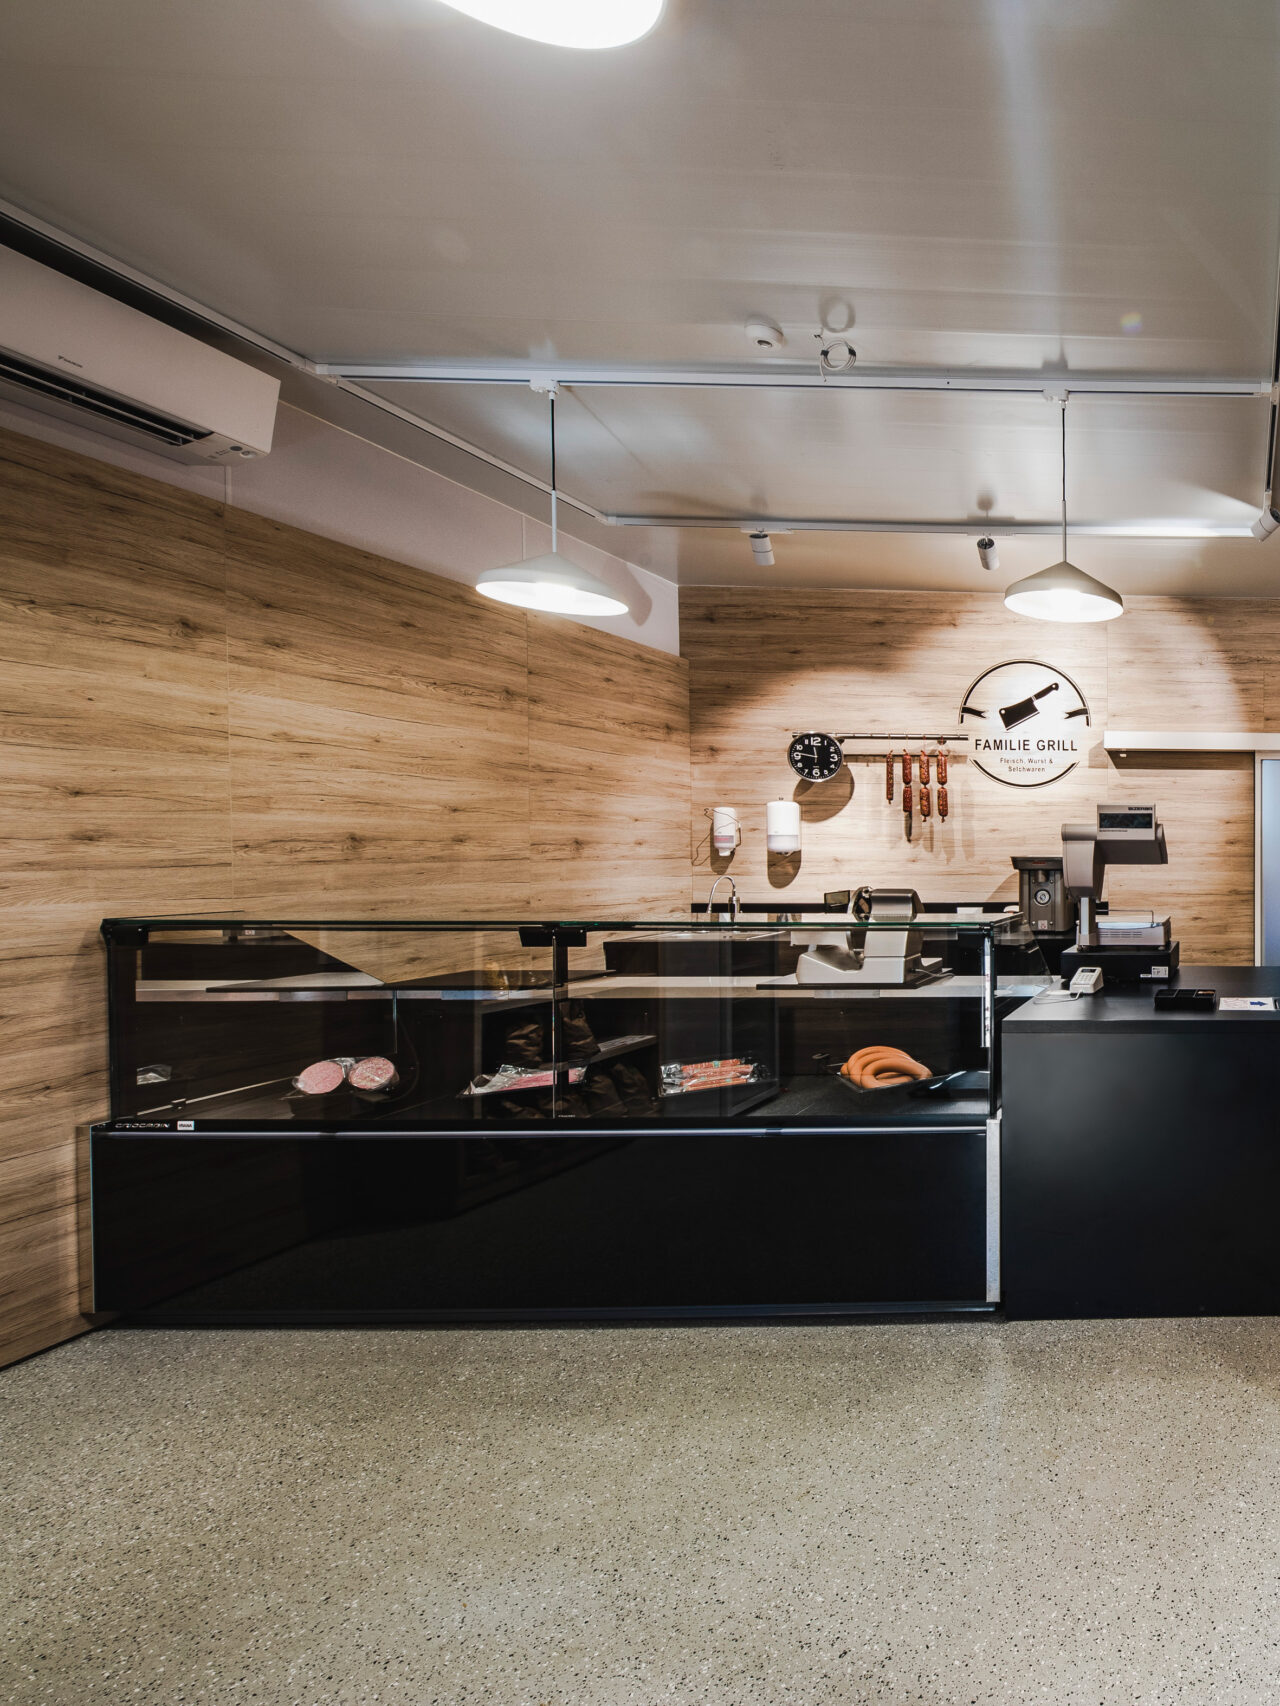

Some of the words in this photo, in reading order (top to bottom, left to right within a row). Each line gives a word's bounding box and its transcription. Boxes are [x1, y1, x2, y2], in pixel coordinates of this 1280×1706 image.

[810, 736, 821, 746] 12
[974, 739, 1030, 751] FAMILIE
[1036, 739, 1078, 751] GRILL
[793, 751, 801, 760] 9
[829, 753, 838, 762] 3
[812, 768, 820, 777] 6
[1008, 765, 1046, 773] Selchwaren
